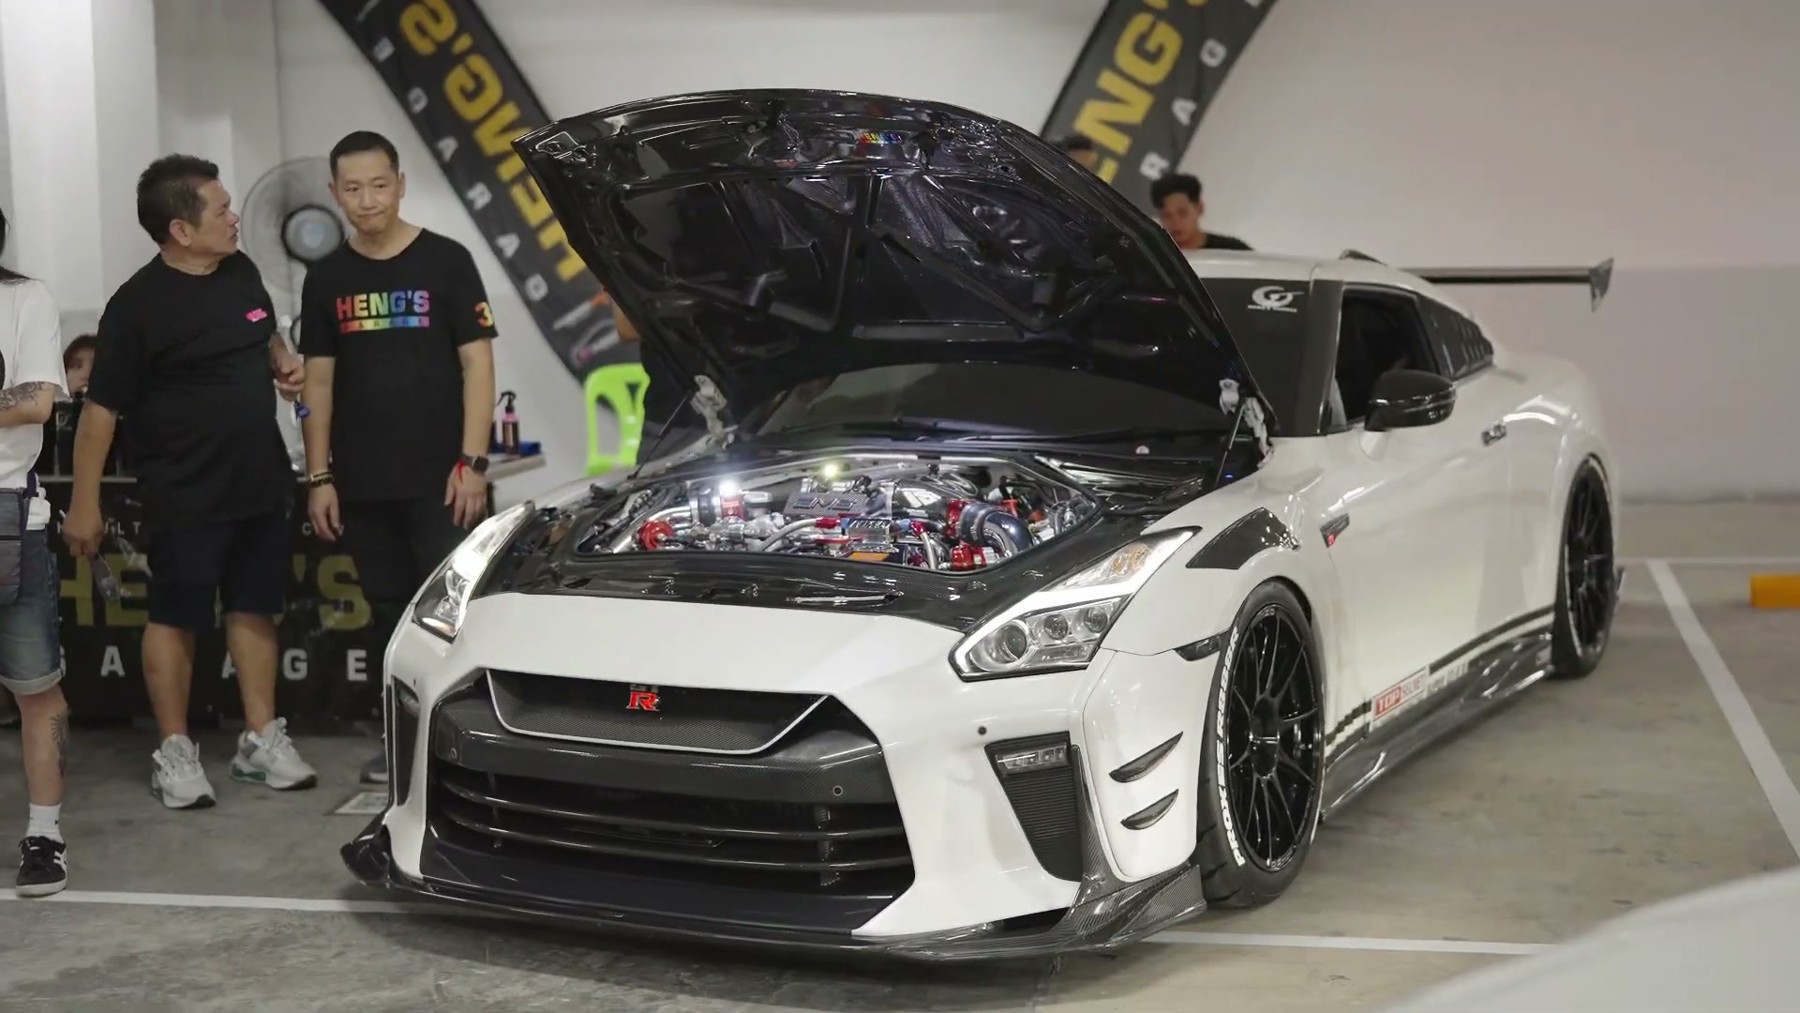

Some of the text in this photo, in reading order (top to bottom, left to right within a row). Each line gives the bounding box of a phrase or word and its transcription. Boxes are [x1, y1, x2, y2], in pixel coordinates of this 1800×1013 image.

[336, 290, 430, 320] HENG'S
[1376, 688, 1401, 715] TOP
[1217, 739, 1247, 867] PROXES
